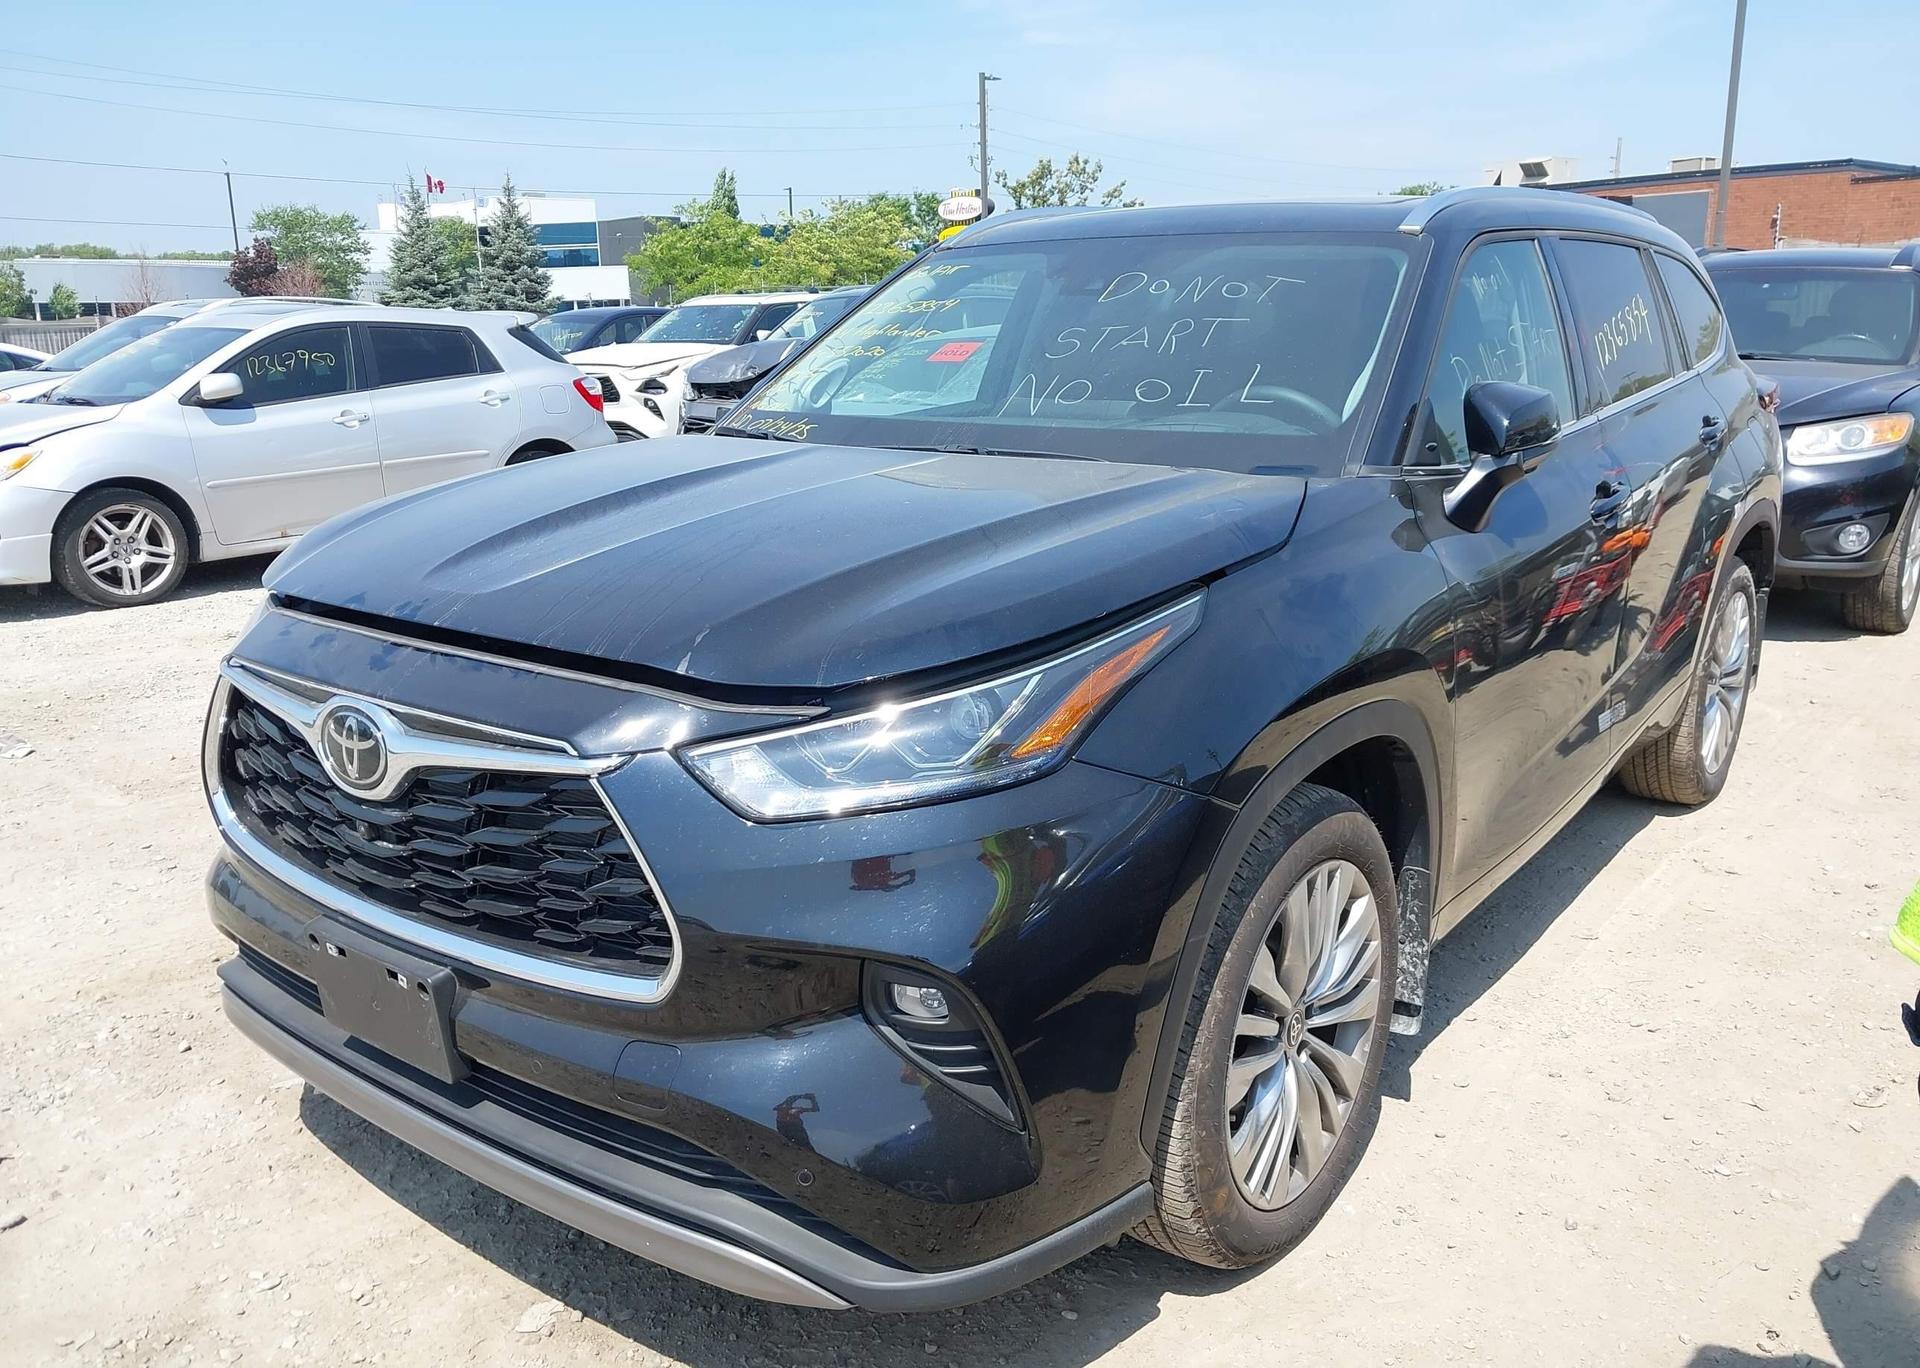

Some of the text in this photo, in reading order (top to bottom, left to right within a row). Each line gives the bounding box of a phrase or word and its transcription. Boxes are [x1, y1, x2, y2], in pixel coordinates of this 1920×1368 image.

[942, 203, 955, 216] Tim
[1045, 318, 1250, 358] START
[1594, 293, 1652, 371] 12365854
[247, 349, 336, 378] 12367950
[937, 348, 970, 357] HOLD
[997, 364, 1274, 417] NO OIL
[748, 416, 818, 439] 07/24/25
